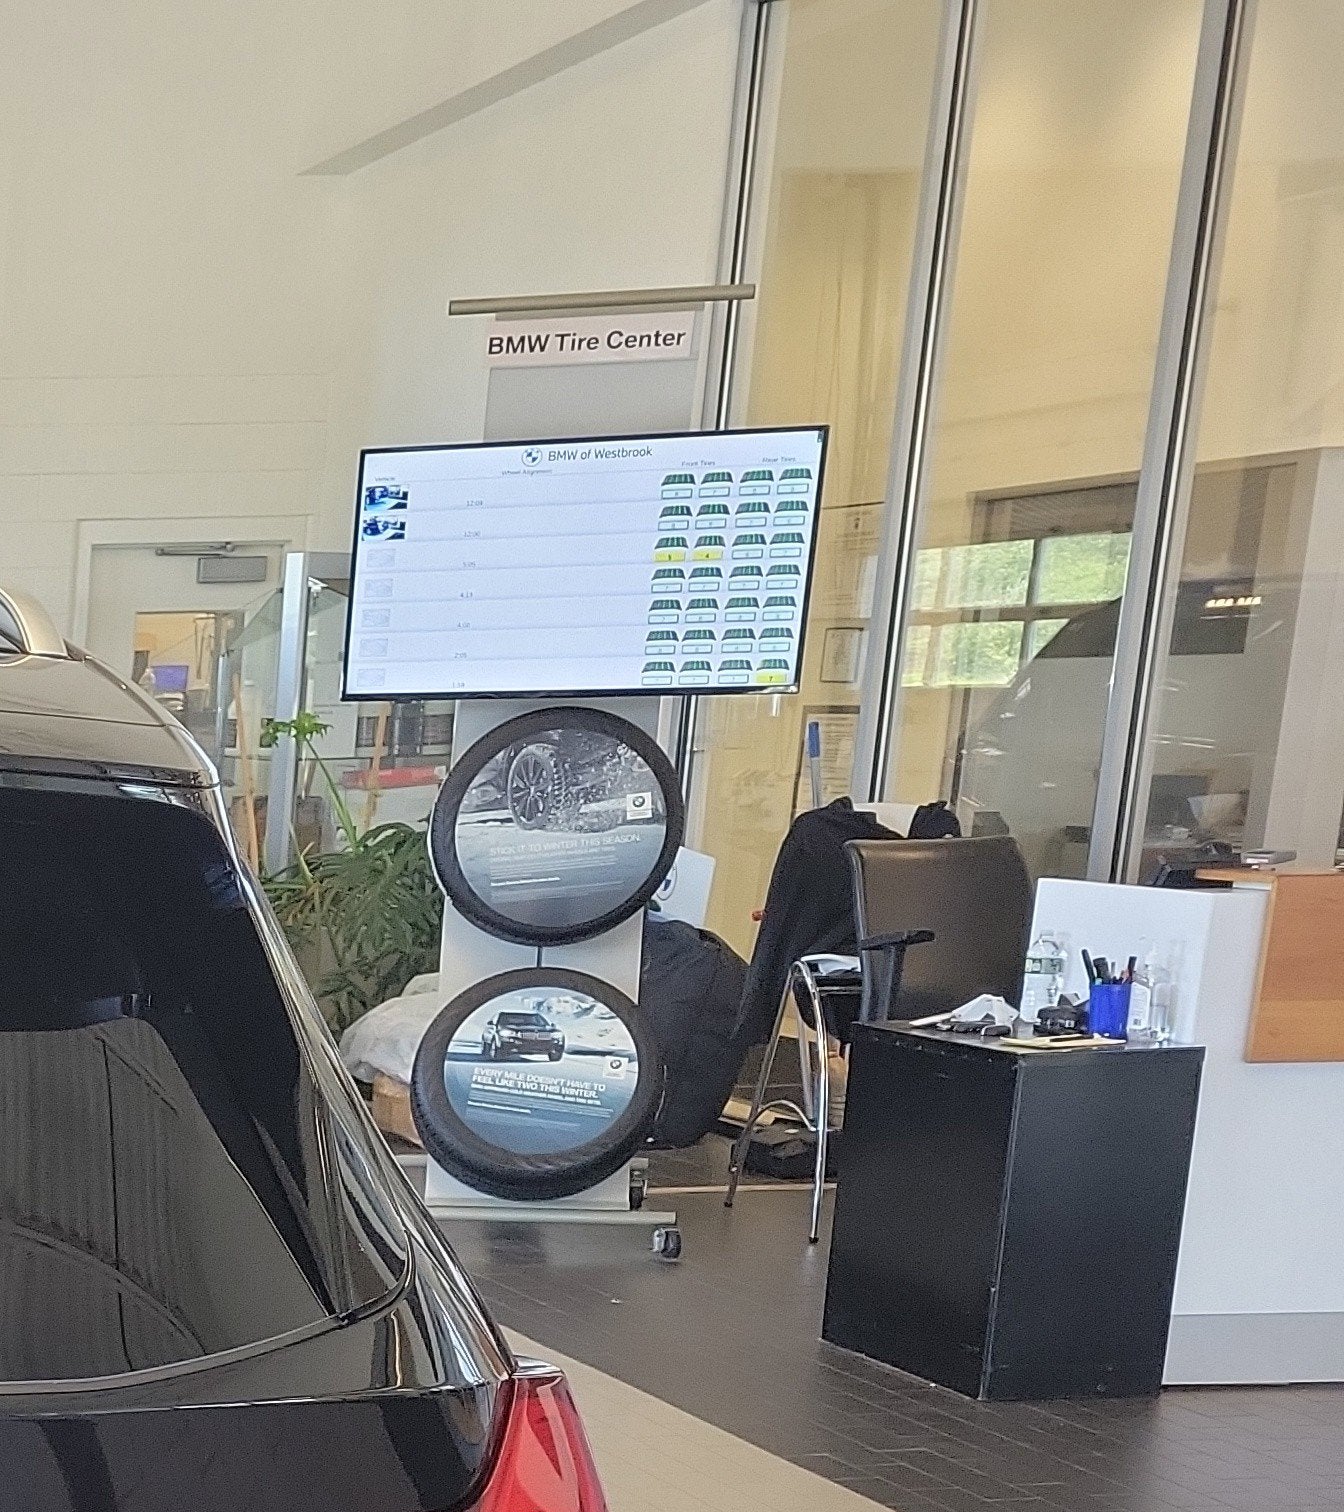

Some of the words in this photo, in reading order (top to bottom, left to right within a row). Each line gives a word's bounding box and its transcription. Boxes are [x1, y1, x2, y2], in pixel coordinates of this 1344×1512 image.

[488, 334, 550, 355] BMW
[555, 332, 600, 351] Tire
[606, 330, 687, 349] Center
[548, 450, 578, 462] BMW
[580, 449, 591, 460] of
[594, 446, 653, 459] Westbrook
[529, 843, 541, 852] TO
[543, 840, 578, 850] WINTER
[581, 838, 600, 848] THIS
[472, 1075, 494, 1085] FEEL
[495, 1077, 515, 1088] LIKE
[517, 1080, 538, 1091] TWO
[540, 1083, 561, 1094] THIS
[474, 1067, 502, 1079] EVERY
[504, 1070, 525, 1081] MILE
[526, 1073, 565, 1086] DOESN'T
[566, 1078, 591, 1090] HAVE
[593, 1082, 606, 1091] TO
